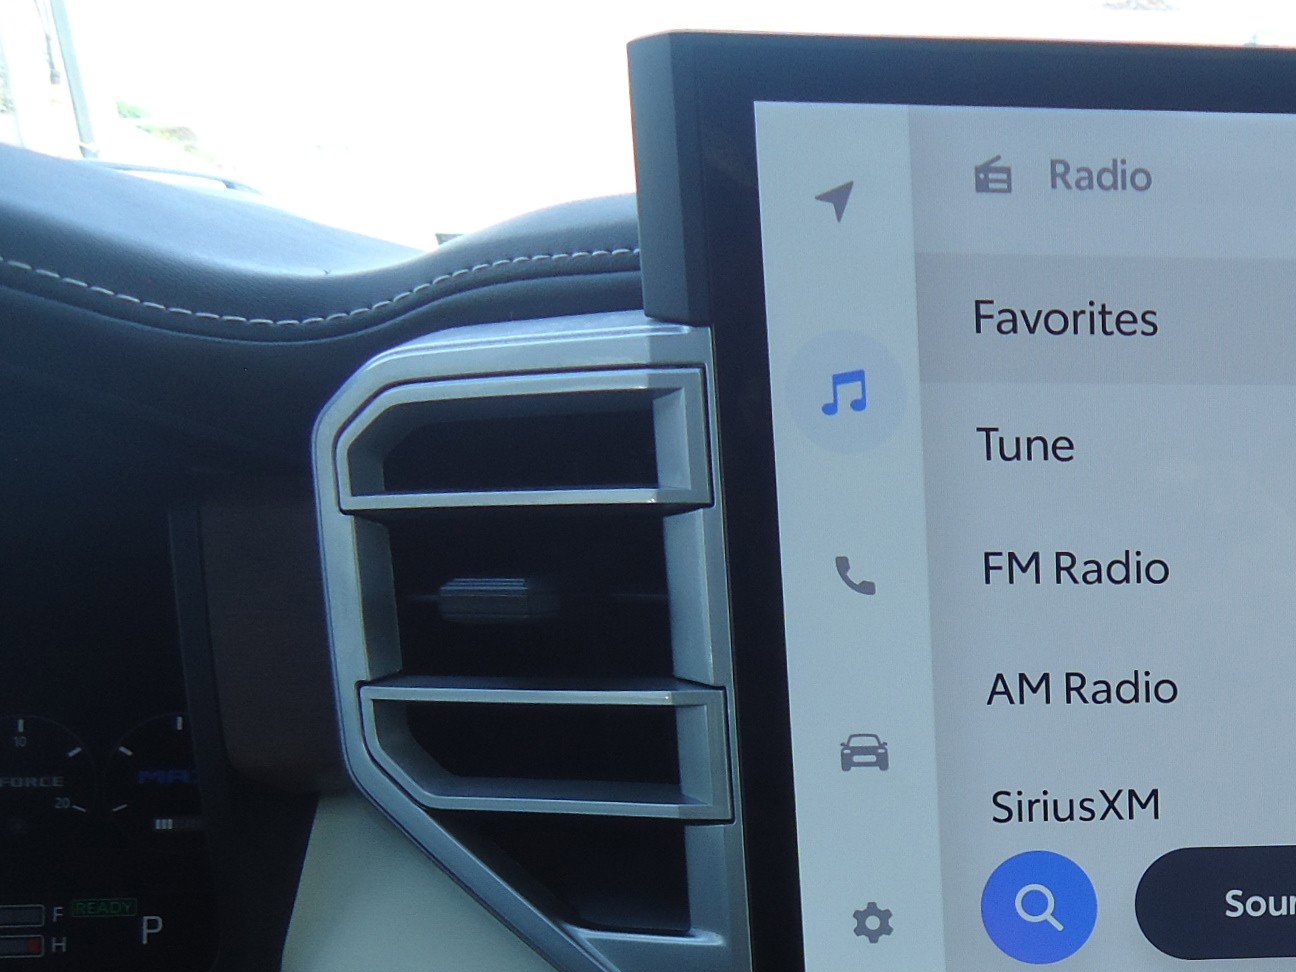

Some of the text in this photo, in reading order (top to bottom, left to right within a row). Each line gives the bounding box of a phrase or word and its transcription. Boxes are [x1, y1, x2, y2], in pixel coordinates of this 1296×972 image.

[1050, 158, 1152, 191] Radio
[974, 299, 1159, 336] Favorites
[976, 428, 1075, 462] Tune
[983, 549, 1170, 584] FM Radio
[986, 669, 1178, 705] AM Radio
[55, 797, 71, 809] 20
[992, 789, 1161, 823] SiriusXM
[53, 907, 64, 922] F
[75, 902, 132, 915] READY
[51, 937, 67, 952] H
[142, 916, 163, 945] P
